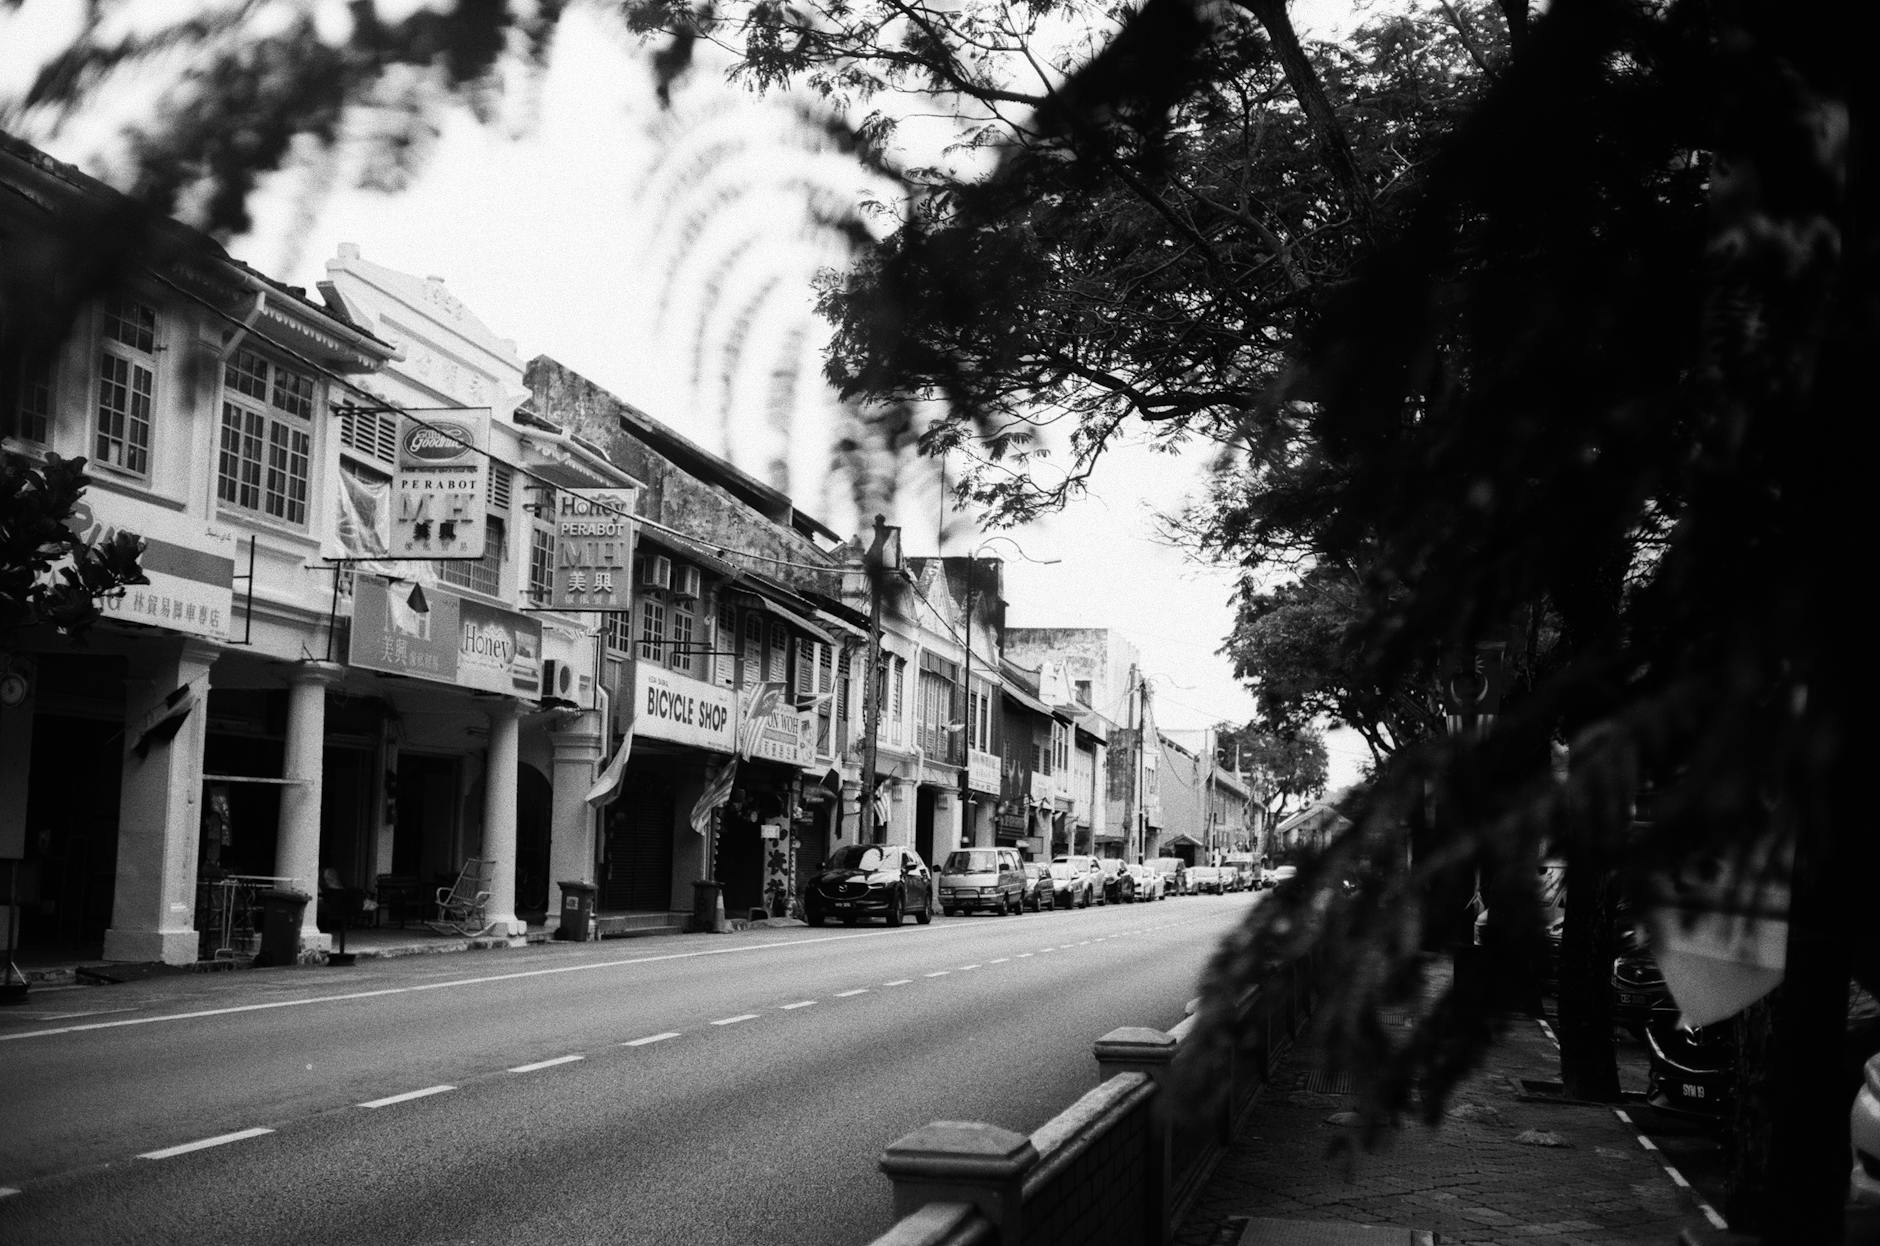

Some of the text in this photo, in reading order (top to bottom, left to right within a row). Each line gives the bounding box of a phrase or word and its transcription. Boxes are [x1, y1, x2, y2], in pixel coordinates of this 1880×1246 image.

[401, 479, 475, 490] PERABOT
[561, 496, 626, 522] Honey
[560, 523, 624, 536] PERABOT
[568, 571, 613, 593] 美興
[464, 623, 511, 668] Honey
[646, 686, 728, 732] BICYCLE SHOP
